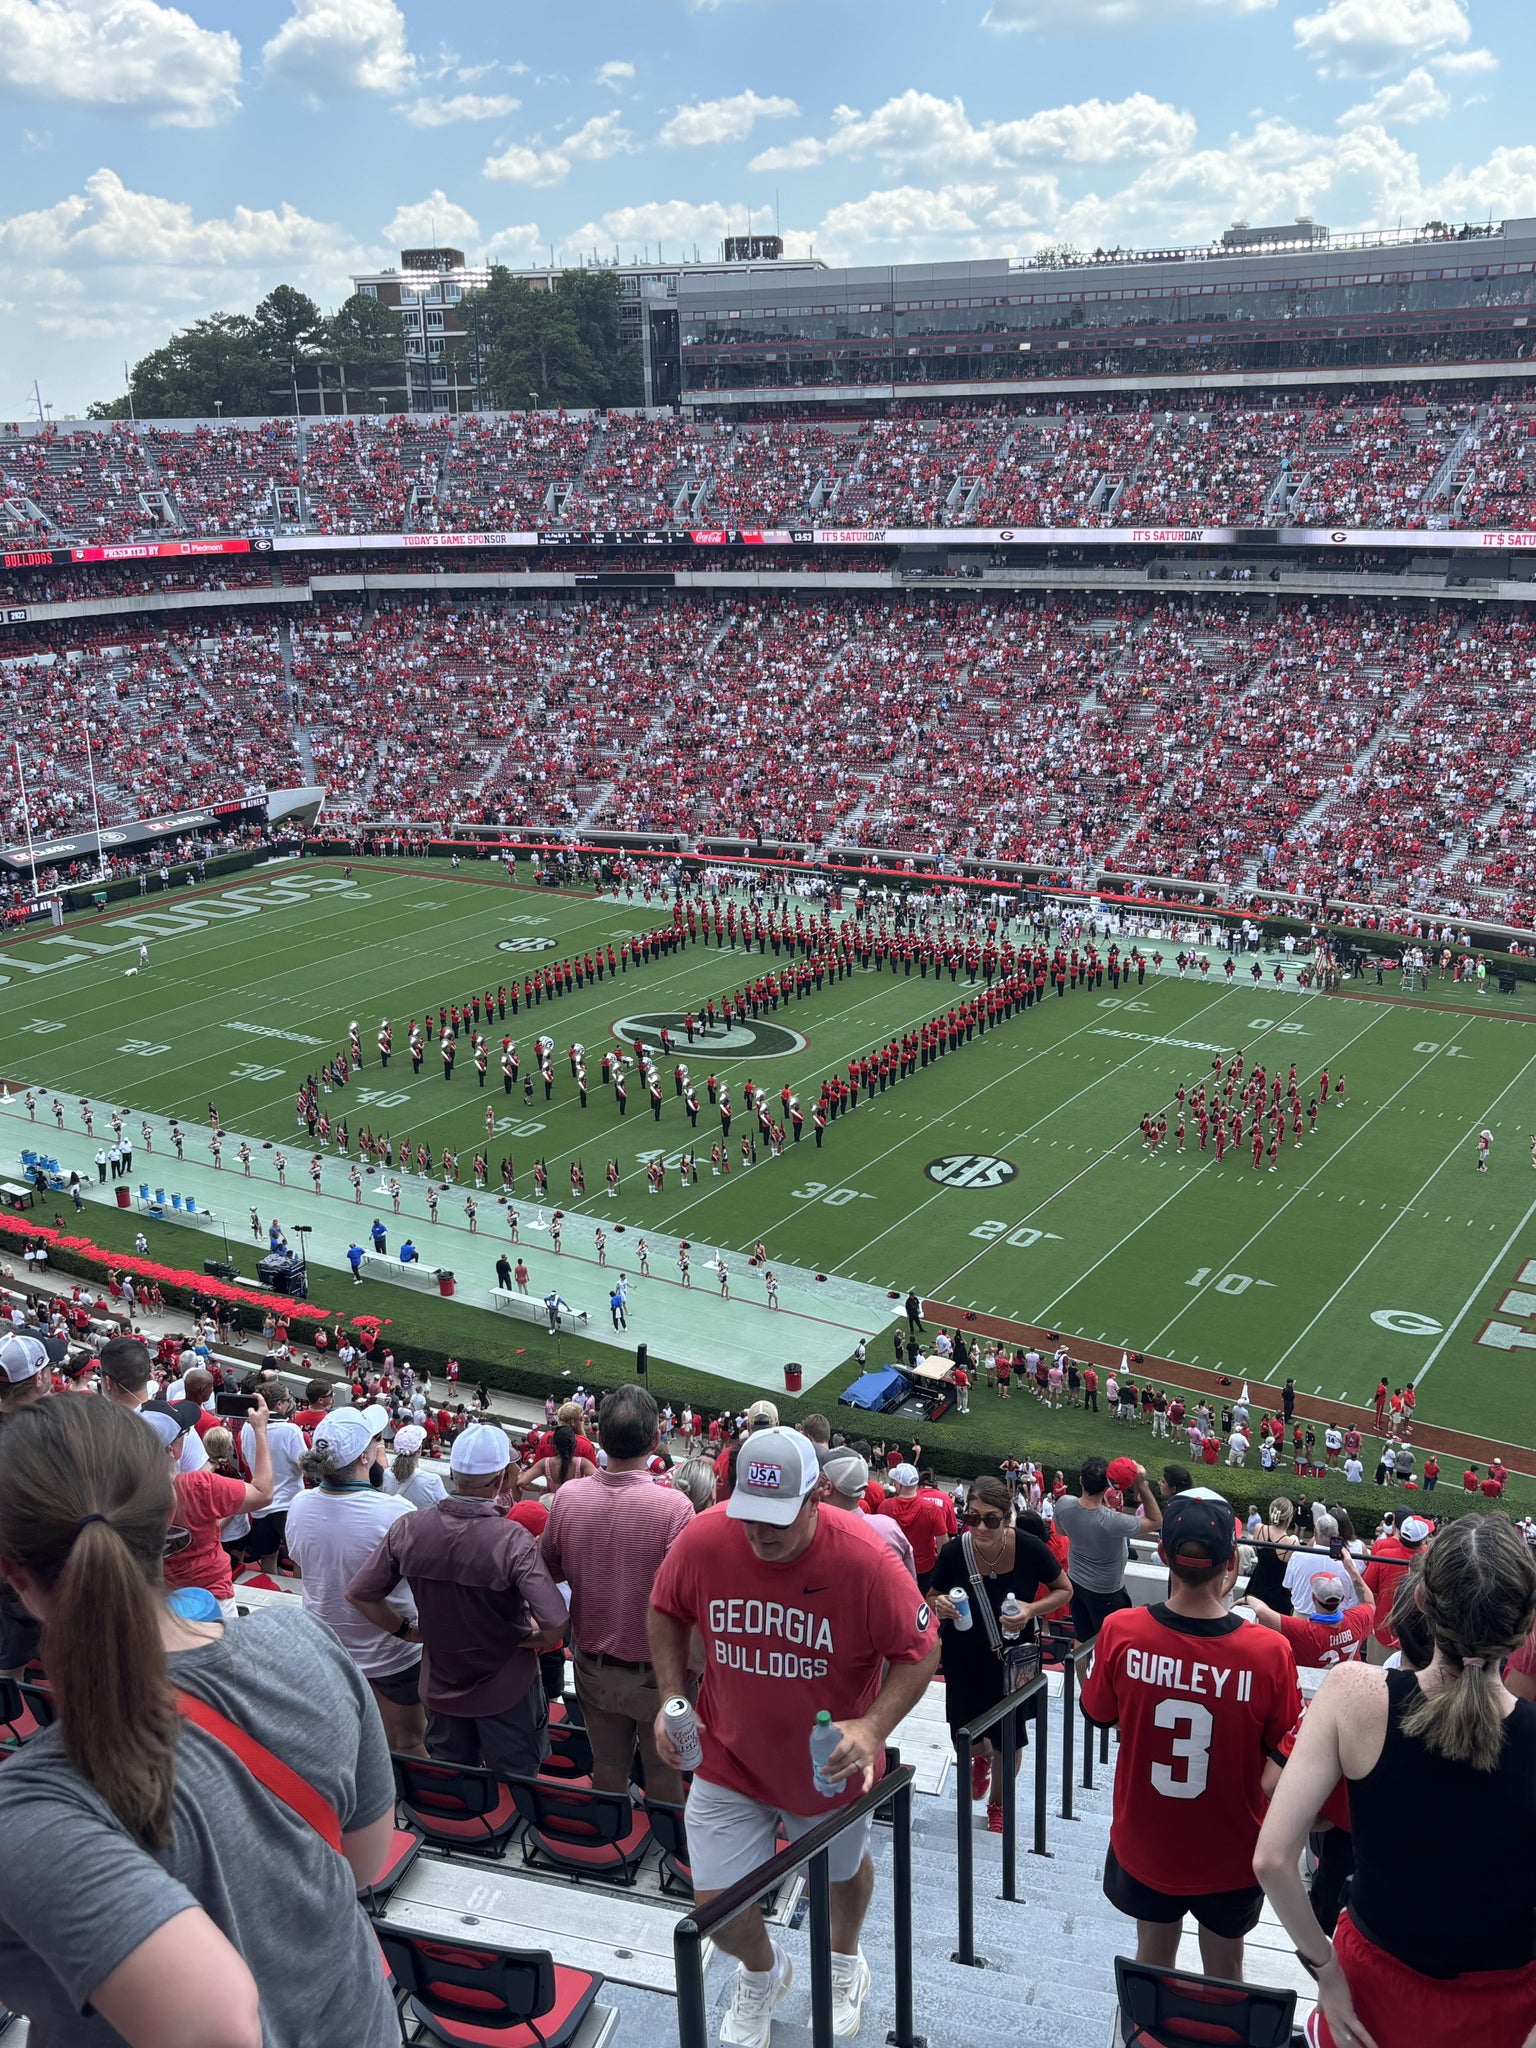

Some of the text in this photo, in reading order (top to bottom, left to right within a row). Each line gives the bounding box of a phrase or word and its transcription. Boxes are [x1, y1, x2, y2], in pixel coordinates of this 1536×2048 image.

[402, 534, 508, 545] TODAY'S GAME SPONSOR
[822, 531, 885, 541] IT'S SATURDAY
[1133, 531, 1203, 541] IT'S SATURDAY
[1483, 534, 1504, 545] IT'S
[103, 546, 159, 558] PRESENTED BY
[191, 543, 224, 552] Piedmont
[4, 552, 53, 568] BULLDOGS
[240, 801, 247, 809] IN
[247, 797, 267, 808] ATHENS
[116, 1040, 172, 1057] 20
[1087, 1028, 1236, 1053] PROGRESSIVE
[228, 1064, 286, 1082] 30
[356, 1089, 411, 1108] 40
[492, 1116, 547, 1138] 50
[791, 1181, 859, 1206] 30
[968, 1220, 1043, 1248] 20
[1185, 1267, 1254, 1296] 10
[750, 1465, 778, 1484] USA
[708, 1598, 835, 1654] GEORGIA
[1329, 1629, 1353, 1647] CHUBB
[714, 1639, 828, 1680] BULLDOGS
[1126, 1647, 1253, 1702] GURLEY II
[1150, 1697, 1215, 1800] 3
